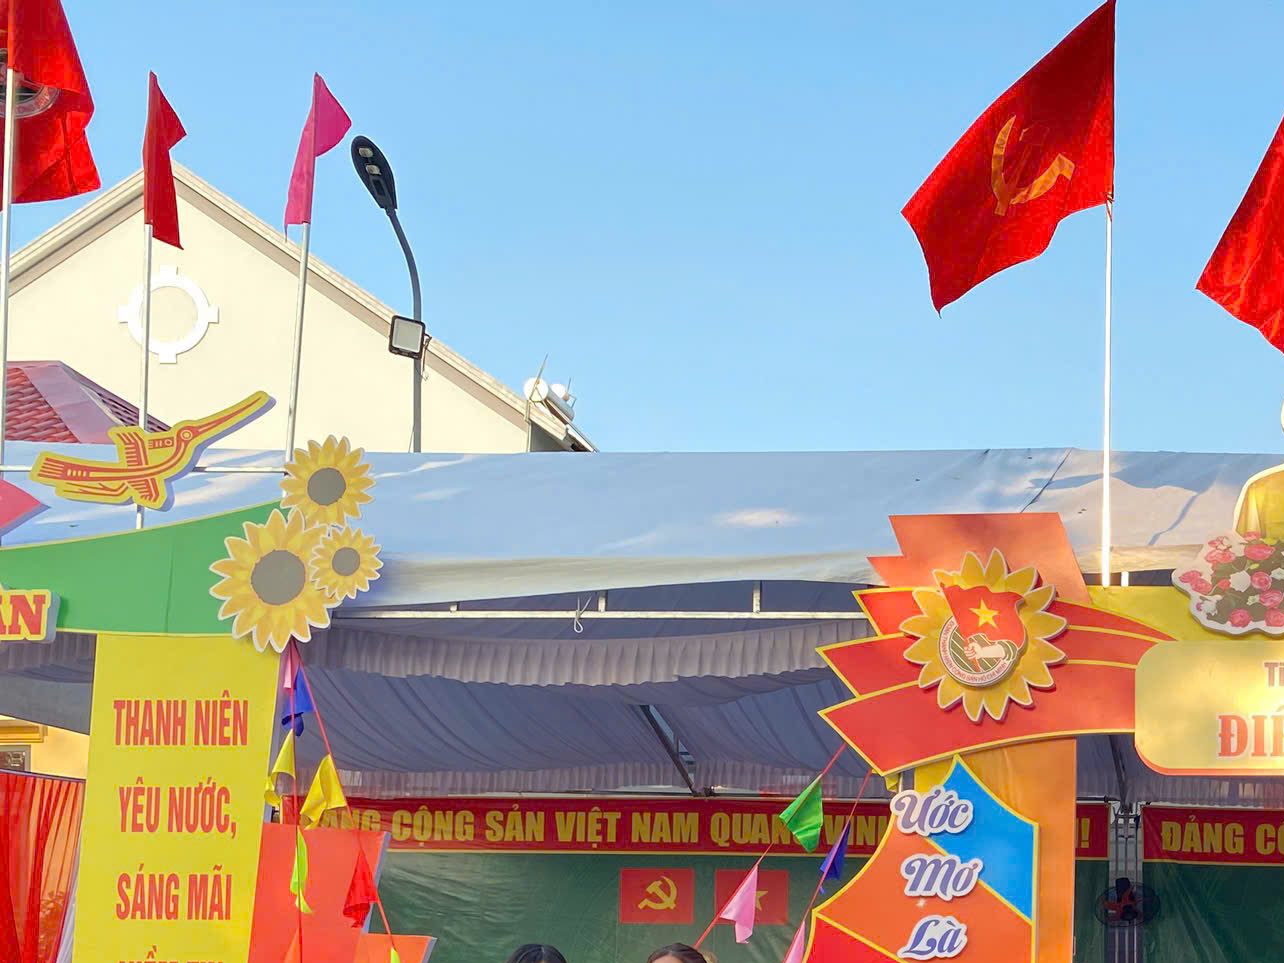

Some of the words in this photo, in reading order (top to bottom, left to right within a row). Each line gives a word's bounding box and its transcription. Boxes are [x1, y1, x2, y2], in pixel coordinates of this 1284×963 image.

[0, 594, 46, 635] N
[113, 699, 187, 746] THANH
[193, 690, 249, 746] NIÊN
[119, 776, 161, 833] YÊU
[168, 776, 237, 839] NƯỚC,
[392, 805, 475, 847] CỘNG
[485, 803, 545, 842] SẢN
[555, 806, 621, 848] VIỆT
[631, 811, 699, 843] NAM
[710, 812, 800, 847] QUAN
[894, 789, 970, 833] Ước
[1160, 814, 1245, 854] ĐẢNG
[115, 863, 180, 920] SÁNG
[187, 864, 232, 920] MÃI
[904, 857, 979, 897] Mơ
[902, 916, 963, 955] Là
